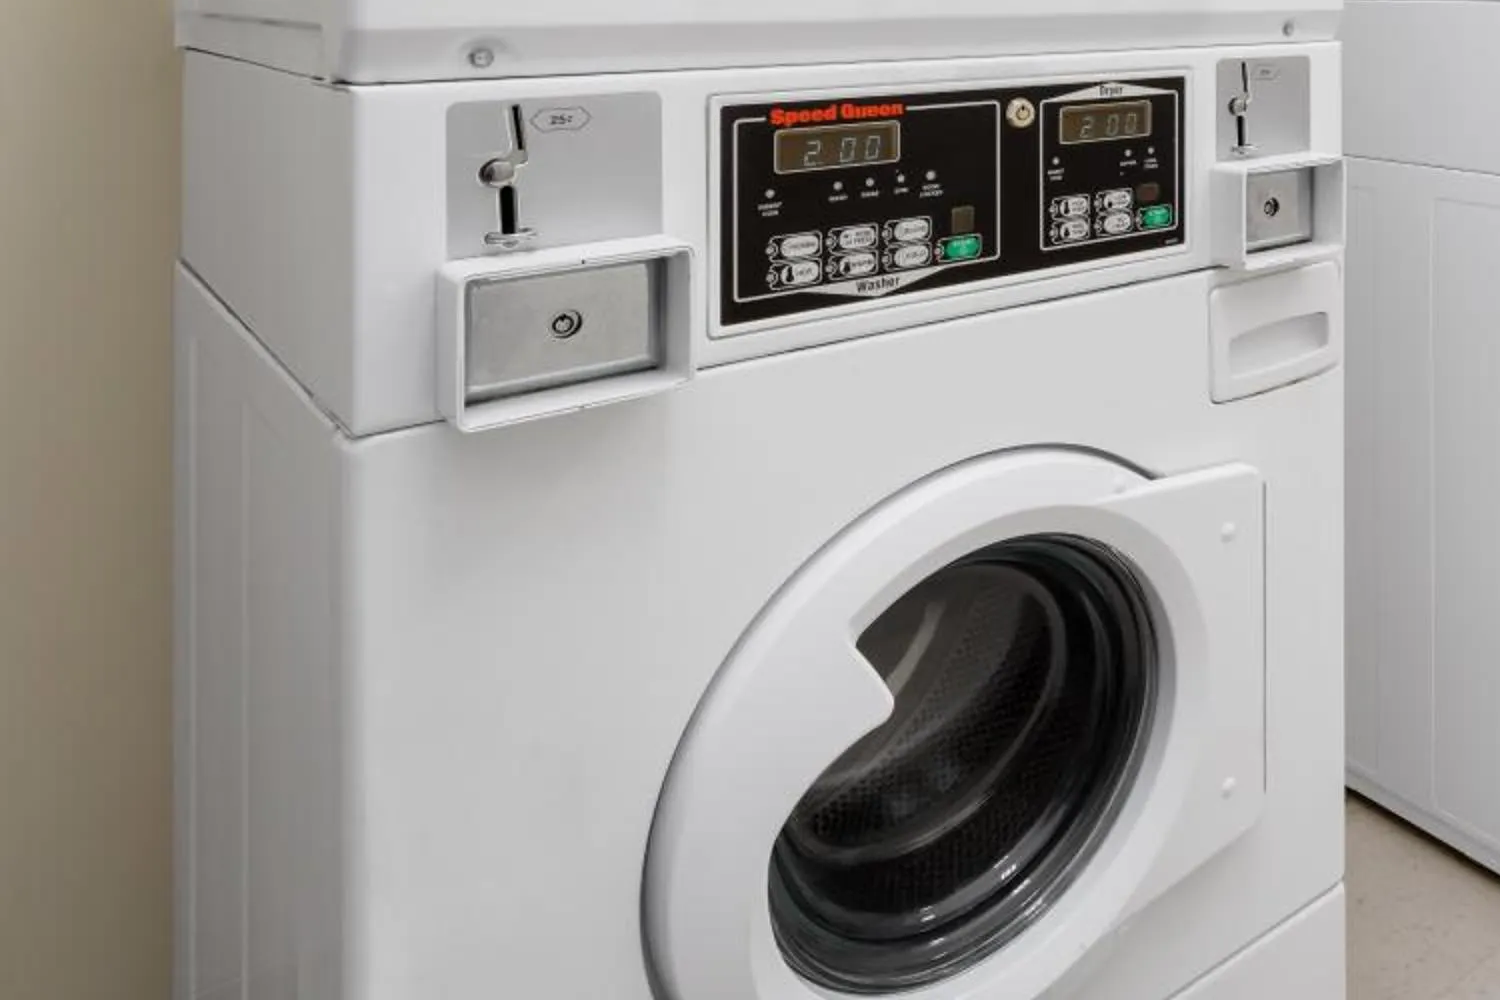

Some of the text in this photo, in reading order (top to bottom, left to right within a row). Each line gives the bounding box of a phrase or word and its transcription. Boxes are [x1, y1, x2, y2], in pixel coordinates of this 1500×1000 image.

[770, 102, 904, 126] Speed Queen
[856, 277, 901, 292] Washer
